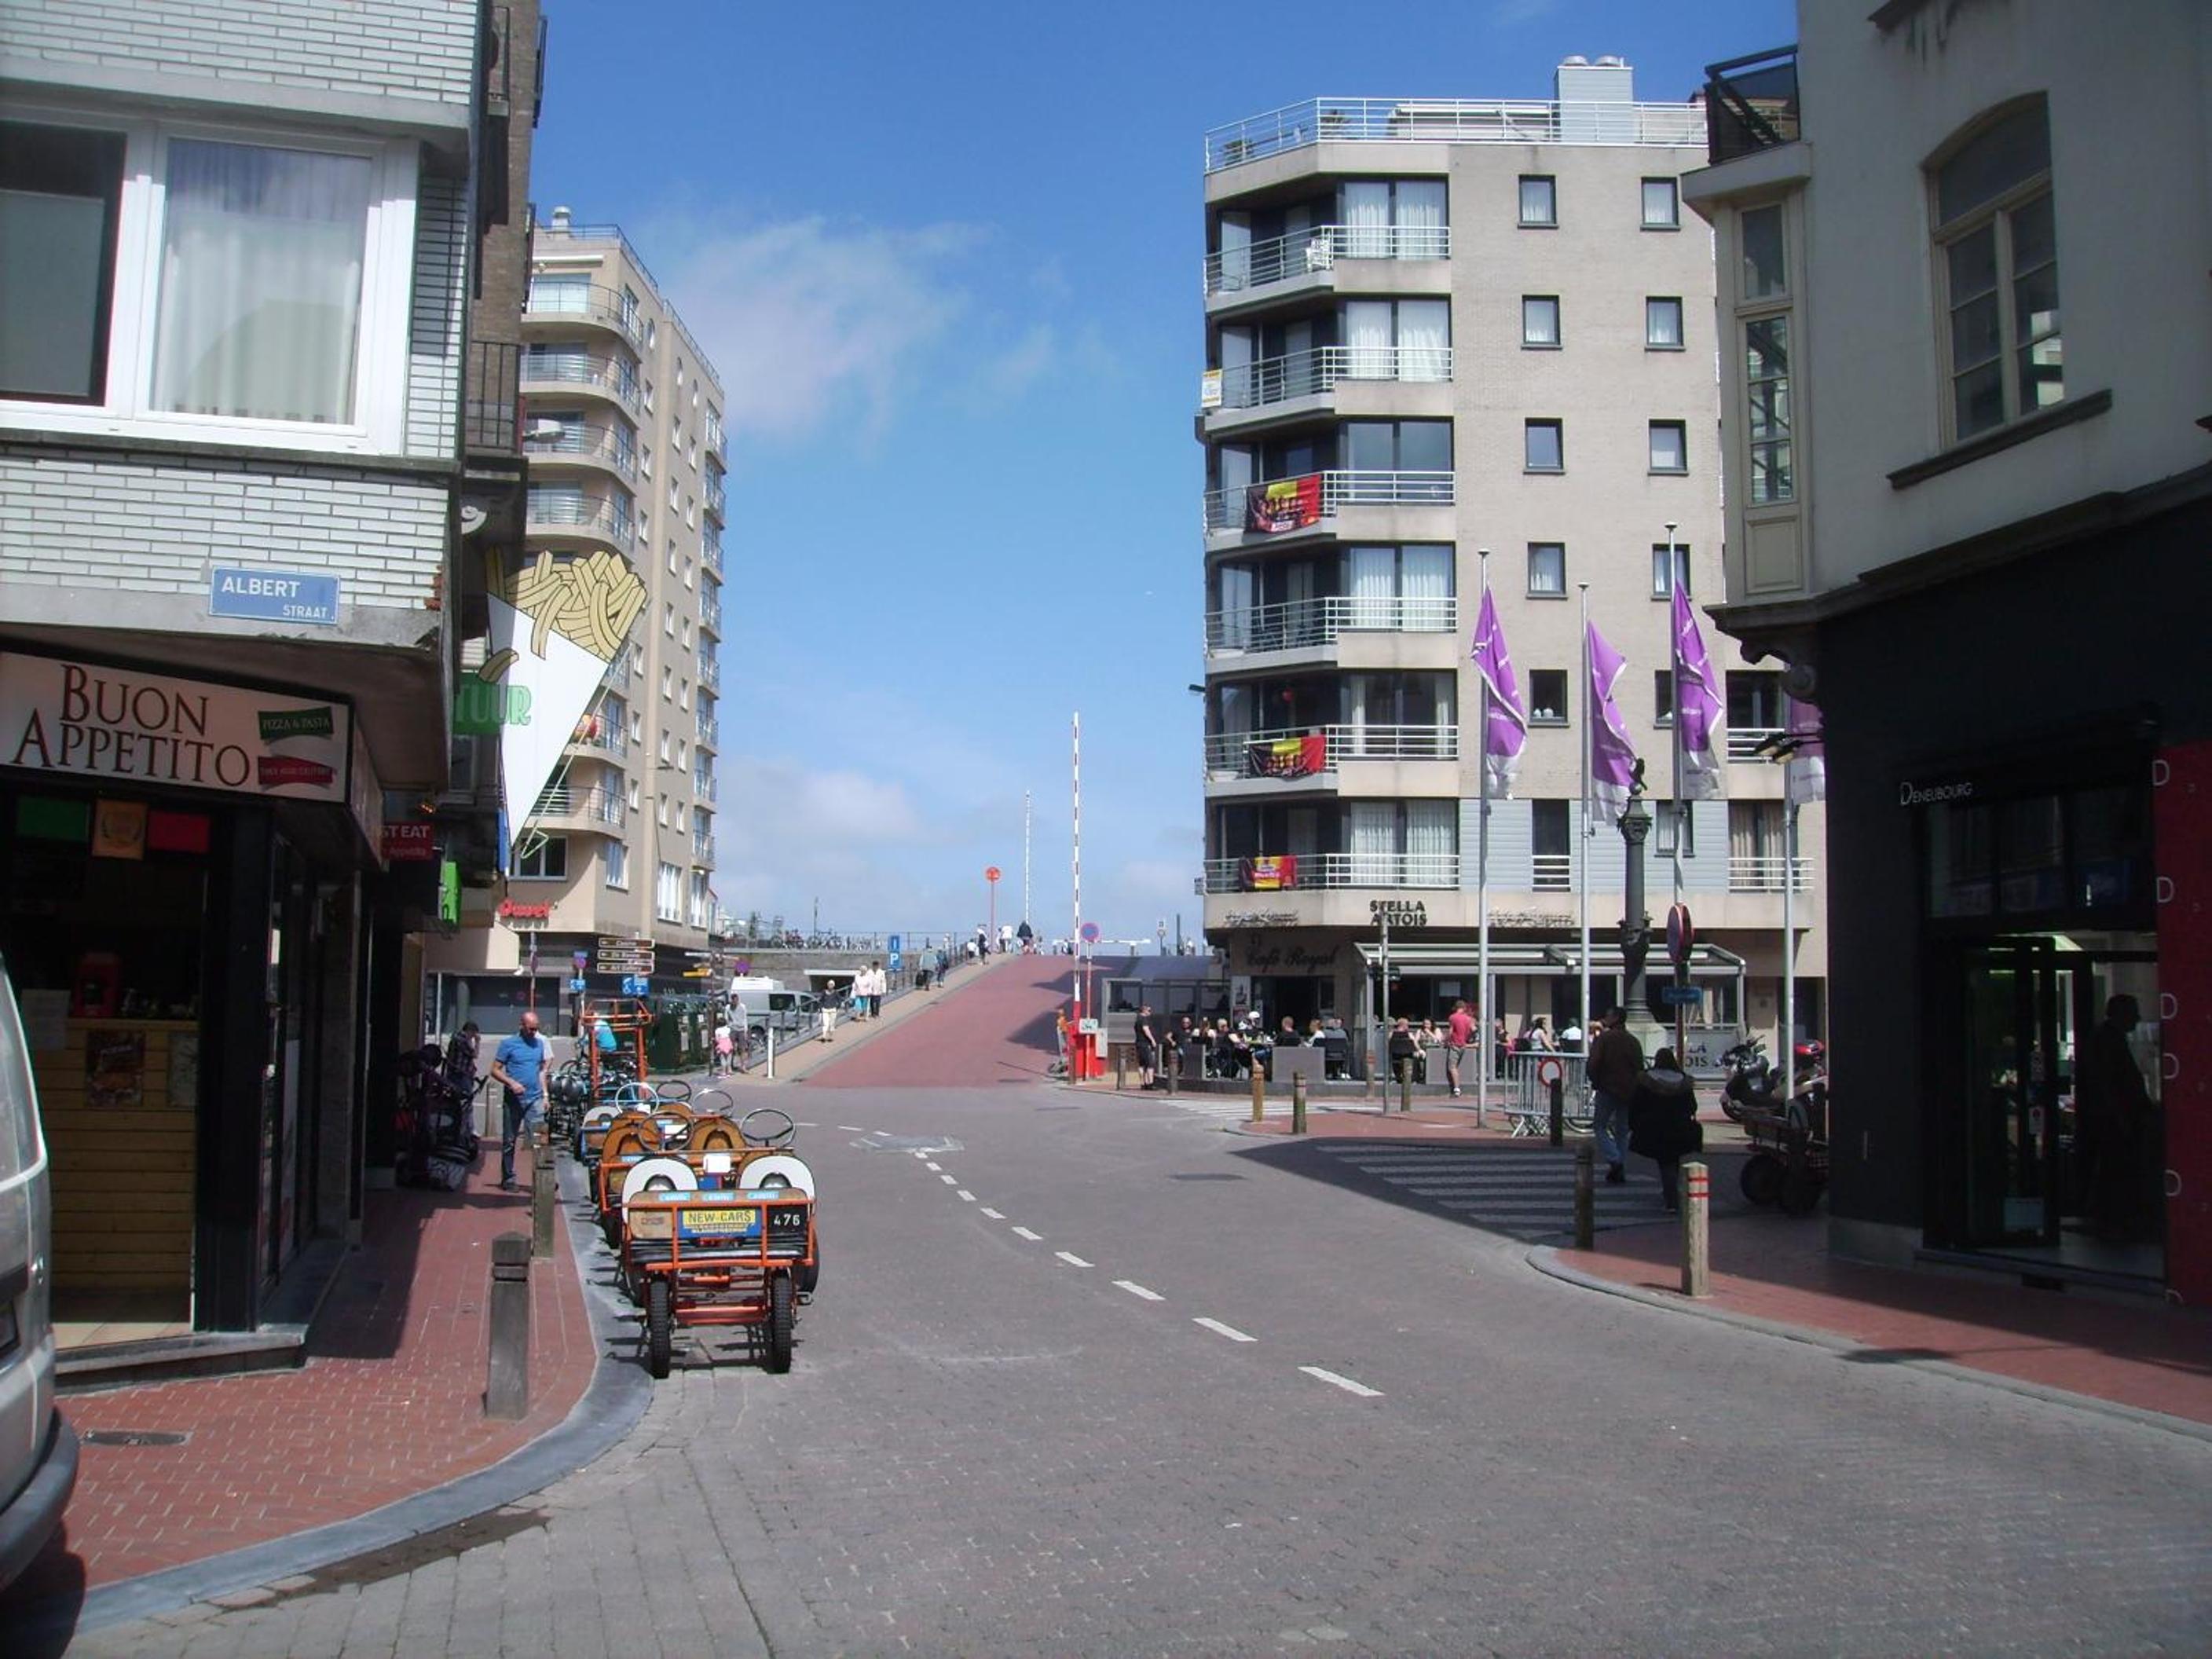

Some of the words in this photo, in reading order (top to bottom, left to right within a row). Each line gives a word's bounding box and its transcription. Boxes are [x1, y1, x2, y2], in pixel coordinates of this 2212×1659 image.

[222, 577, 300, 598] ALBERT
[283, 604, 328, 619] STRAAT
[59, 664, 208, 737] BUON
[262, 718, 291, 731] PIZZA
[9, 708, 250, 786] APPETITO
[401, 824, 430, 838] EAT
[1370, 900, 1425, 912] STELLA
[688, 1211, 715, 1223] NEW
[720, 1210, 752, 1222] CARS
